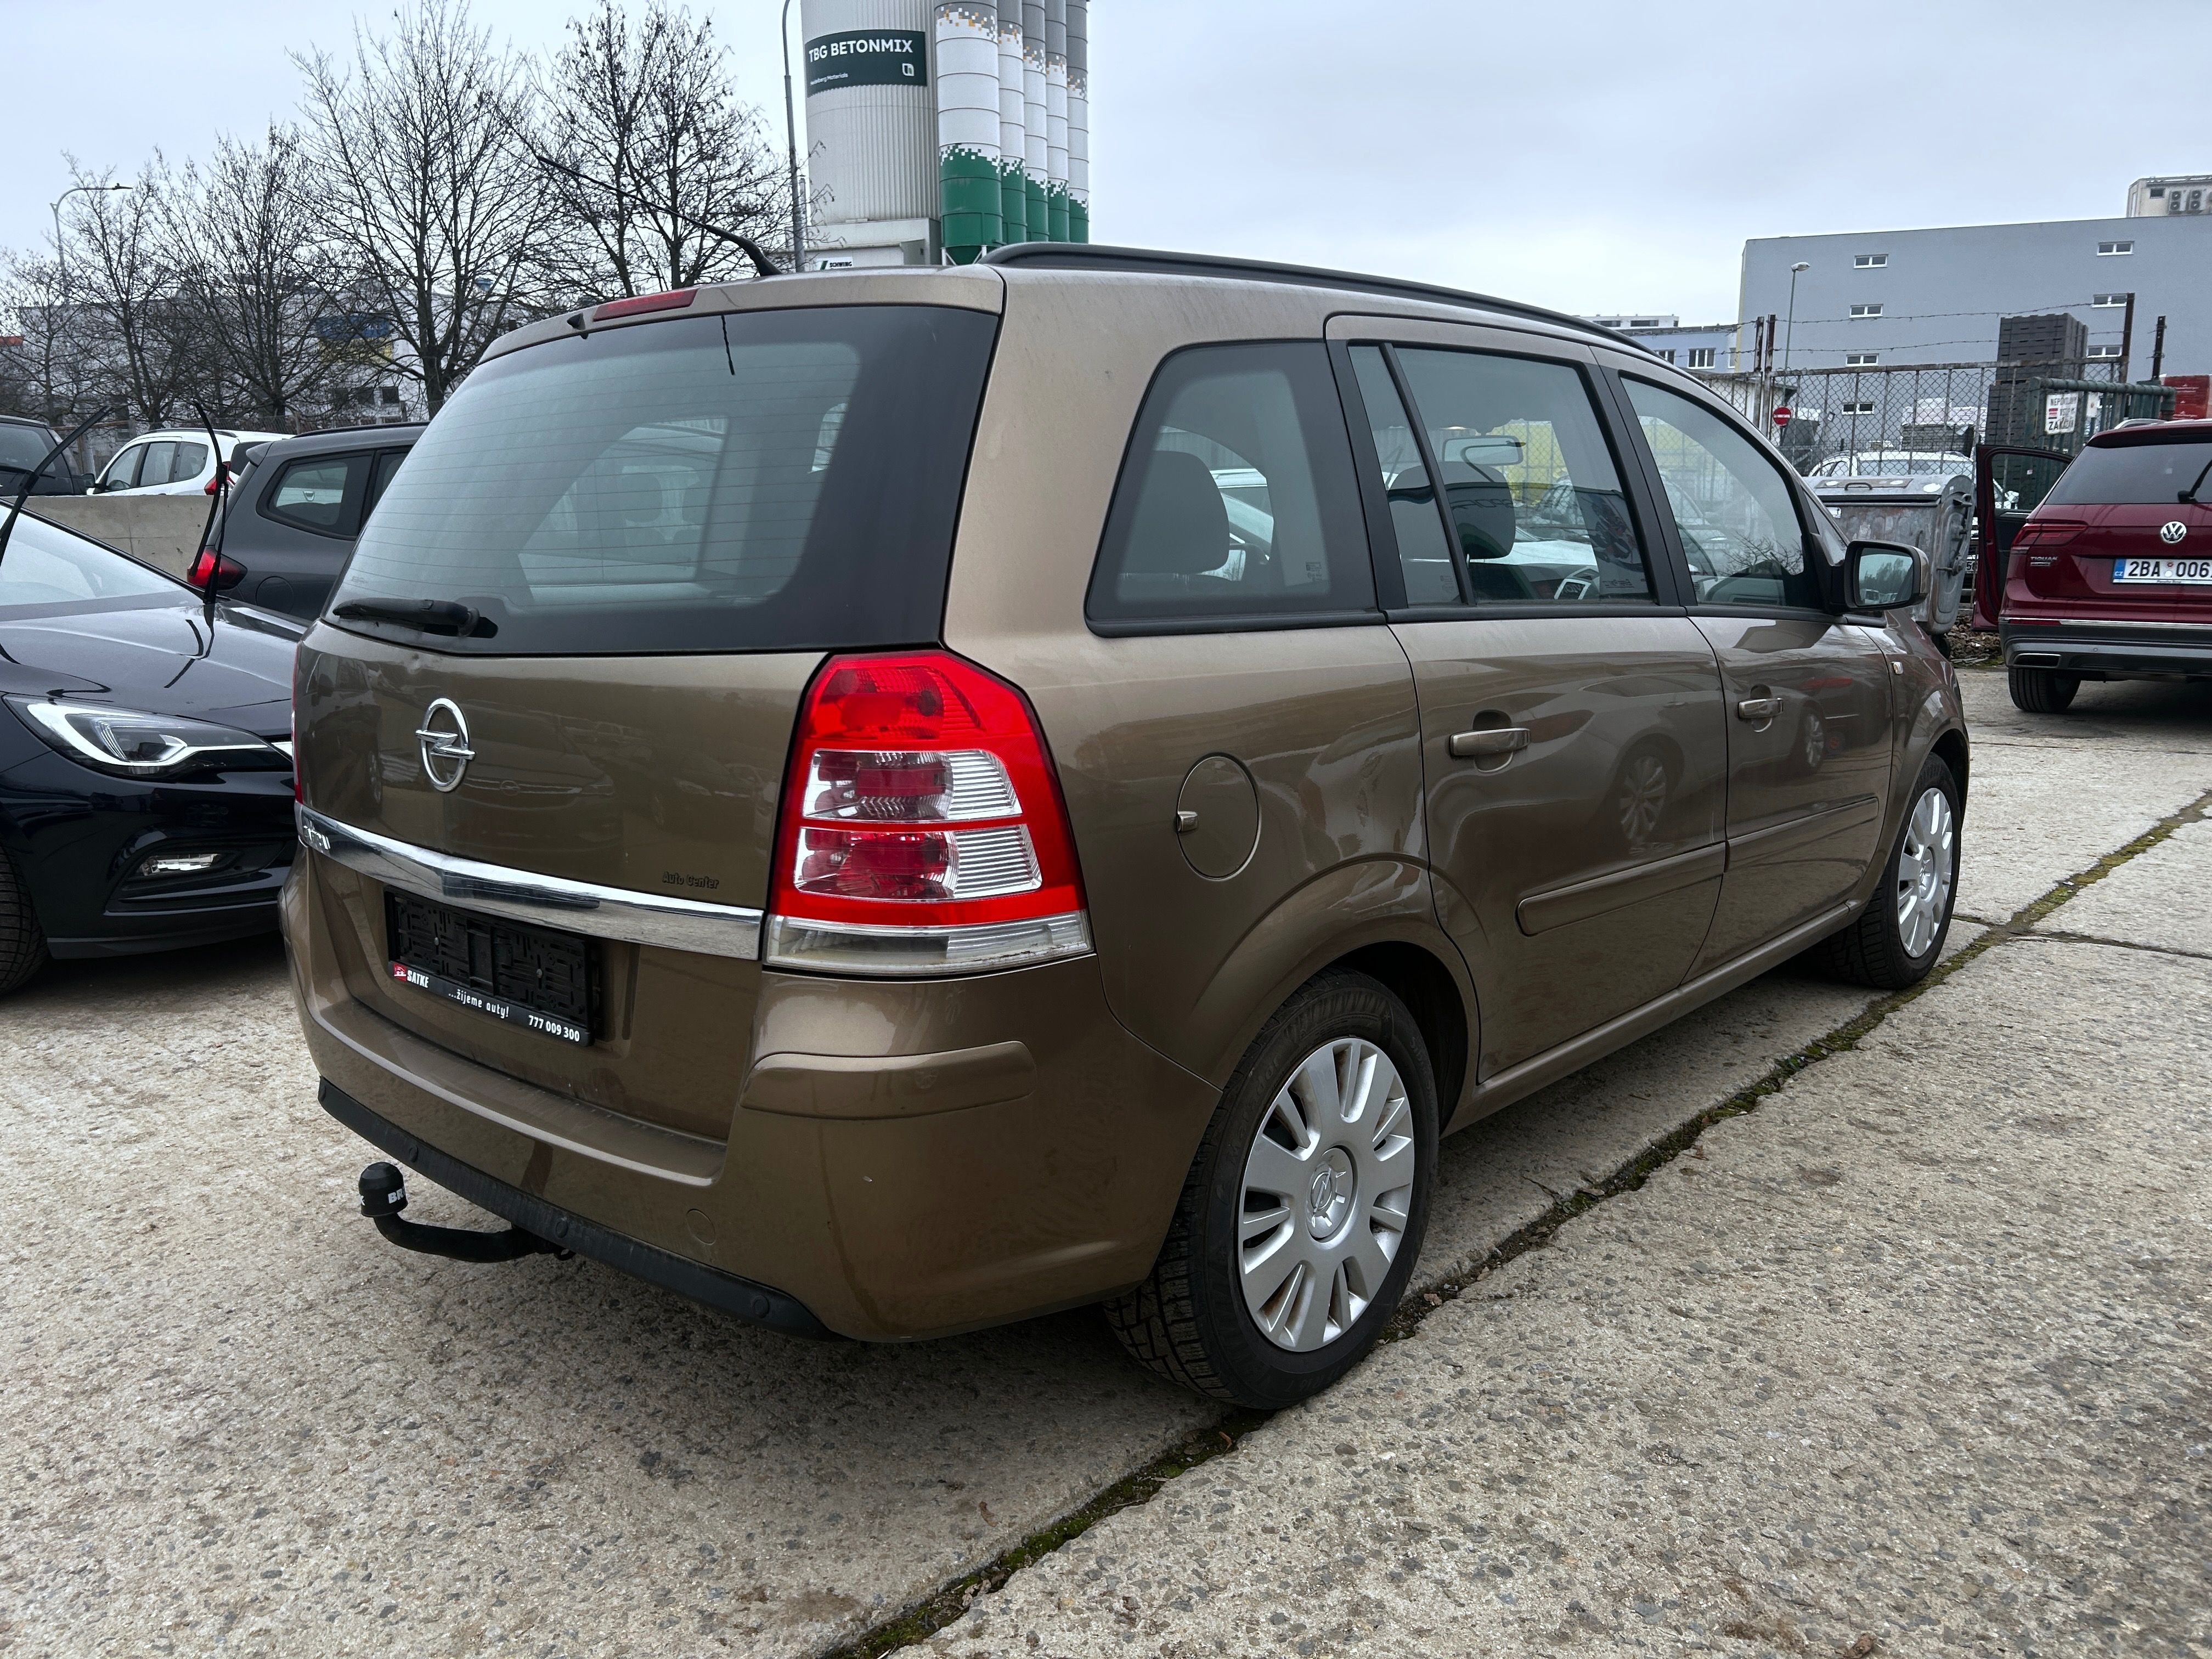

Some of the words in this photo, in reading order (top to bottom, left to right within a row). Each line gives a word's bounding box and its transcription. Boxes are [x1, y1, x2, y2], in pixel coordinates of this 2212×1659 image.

[809, 45, 828, 63] TBG
[830, 39, 913, 57] BETONMIX
[2128, 561, 2160, 577] 2BA
[2176, 561, 2212, 578] 006
[662, 871, 685, 885] Auto
[686, 874, 720, 889] Center
[407, 970, 430, 988] SATKE
[486, 1001, 510, 1019] auty!
[528, 1014, 544, 1029] 777
[546, 1020, 562, 1035] 009
[563, 1026, 580, 1042] 300
